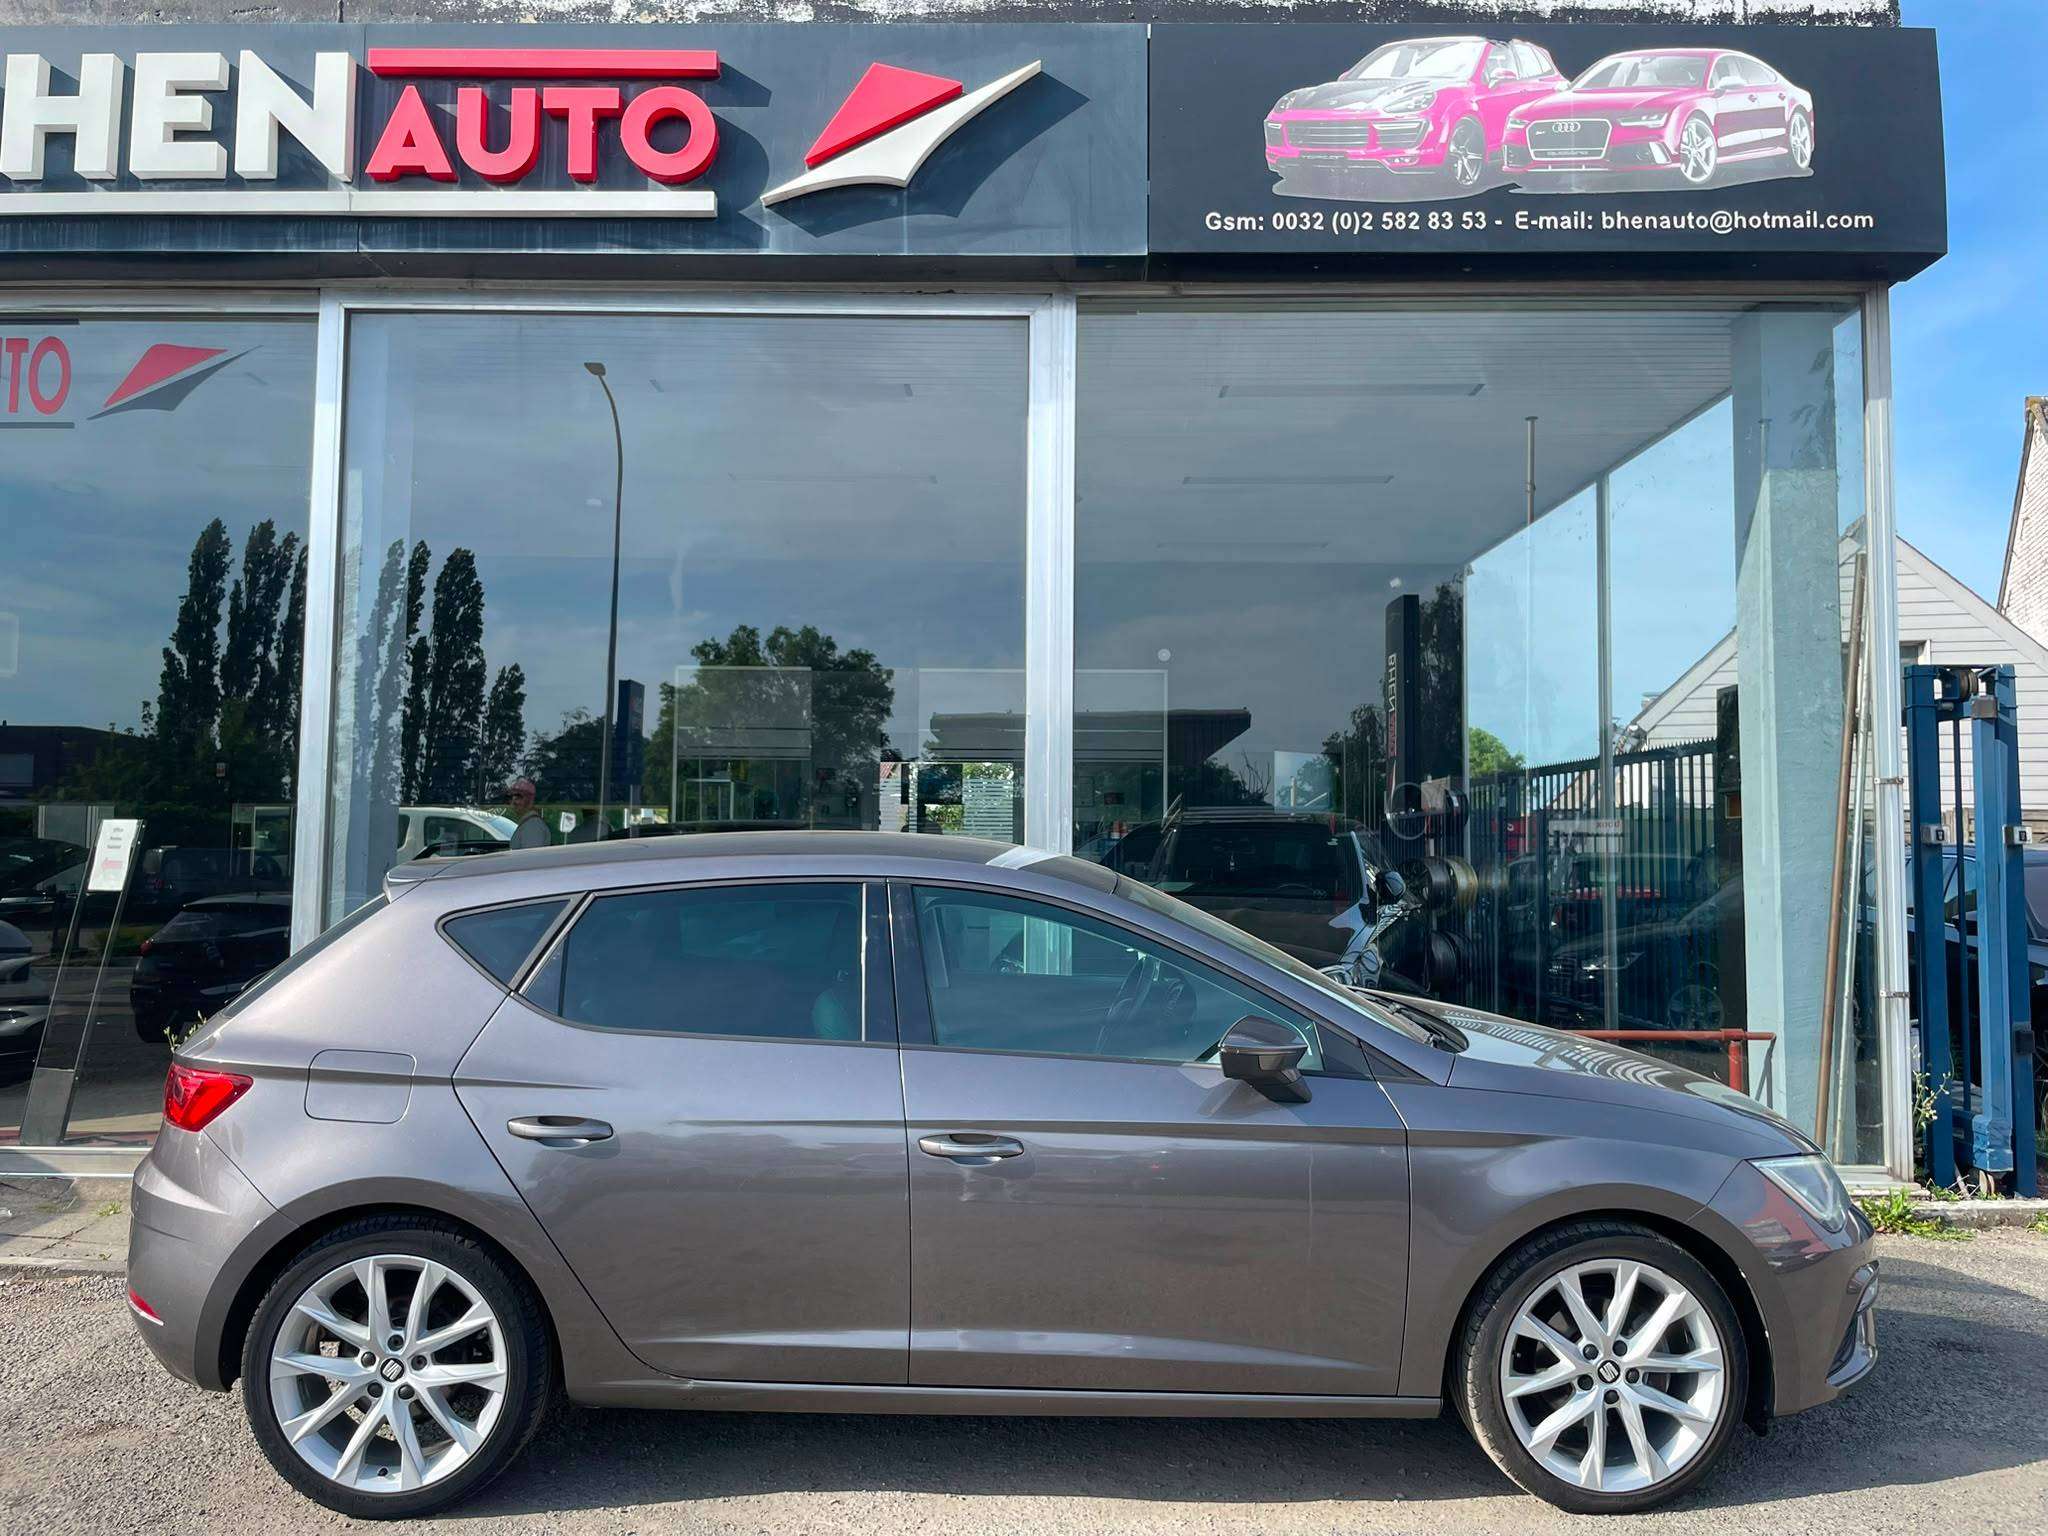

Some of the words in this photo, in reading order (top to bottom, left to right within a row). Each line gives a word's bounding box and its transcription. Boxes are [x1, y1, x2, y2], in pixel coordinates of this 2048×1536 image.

[365, 85, 719, 184] AUTO
[1205, 211, 1264, 231] Gsm:
[1272, 211, 1325, 231] 0032
[1331, 211, 1374, 235] (0)2
[1381, 211, 1420, 230] 582
[1427, 211, 1454, 230] 83
[1461, 210, 1487, 230] 53
[1514, 210, 1593, 230] E-mail:
[1601, 209, 1874, 235] bhenauto@hotmail.com
[0, 336, 72, 415] TO
